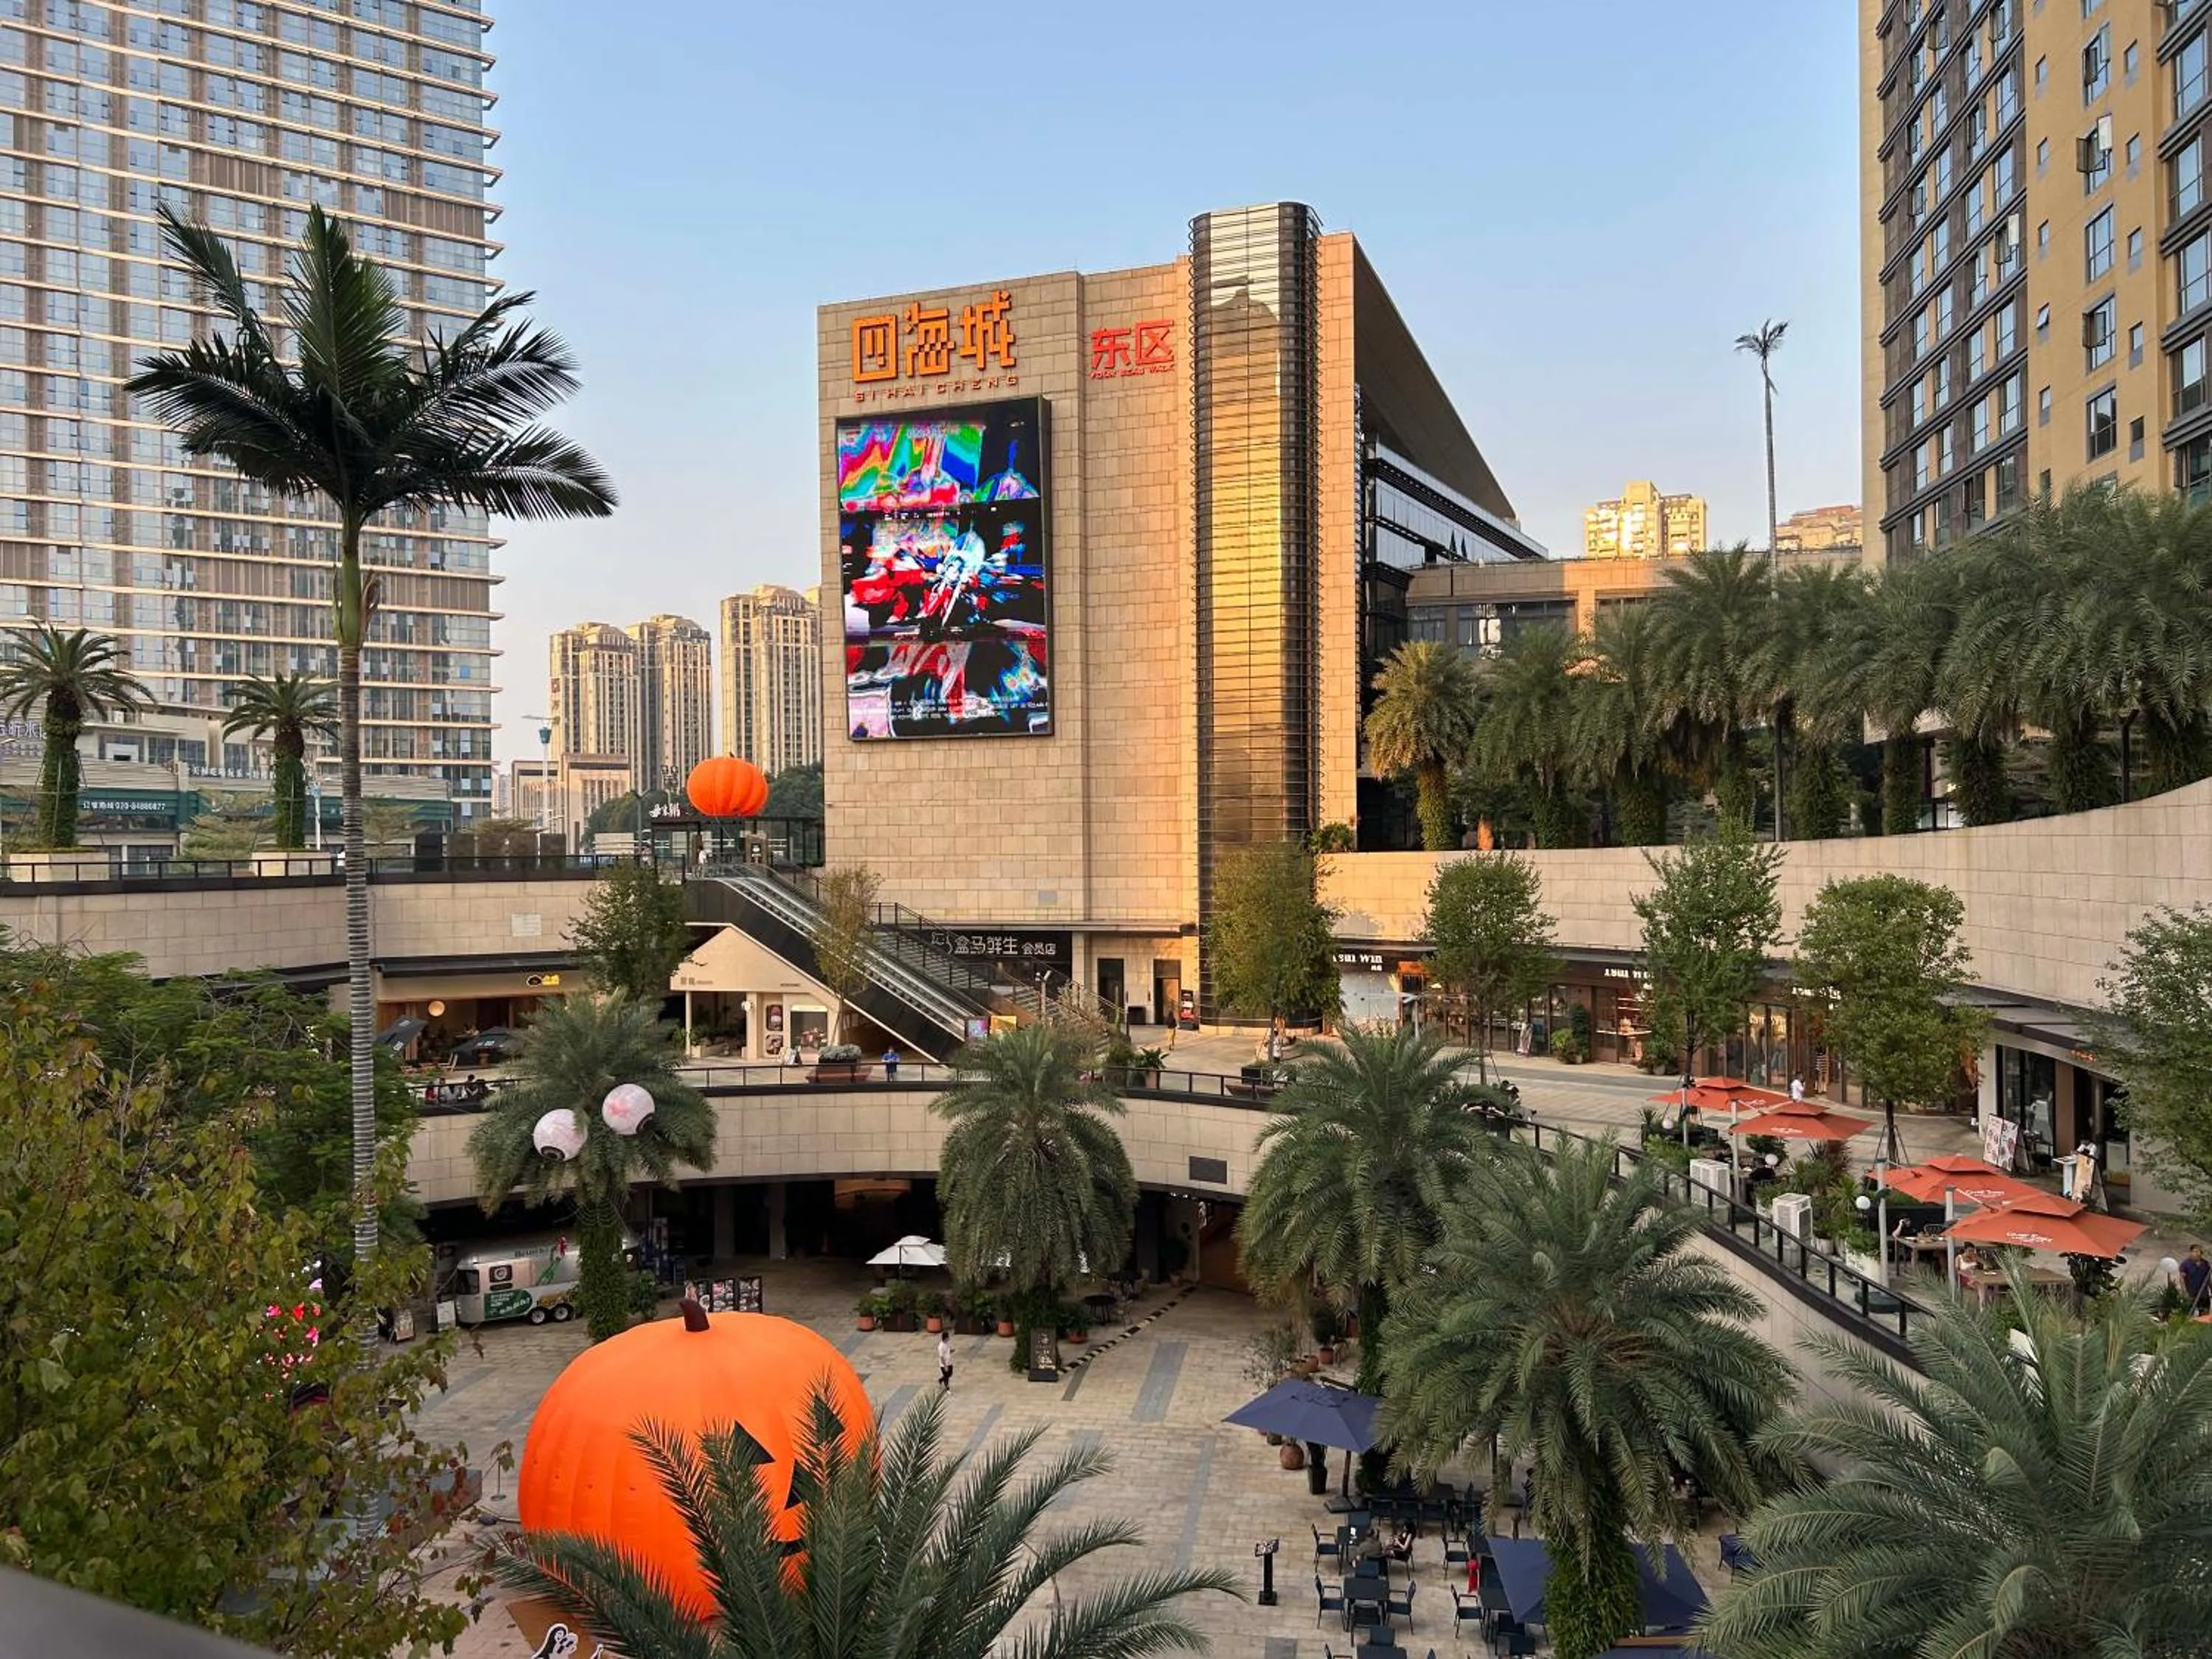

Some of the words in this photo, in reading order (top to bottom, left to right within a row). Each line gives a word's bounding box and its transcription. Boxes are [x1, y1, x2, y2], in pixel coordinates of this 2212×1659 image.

[852, 290, 1016, 383] 四海城
[1091, 319, 1174, 369] 东区
[954, 935, 1018, 955] 盒马鲜生
[1021, 942, 1057, 956] 会员店
